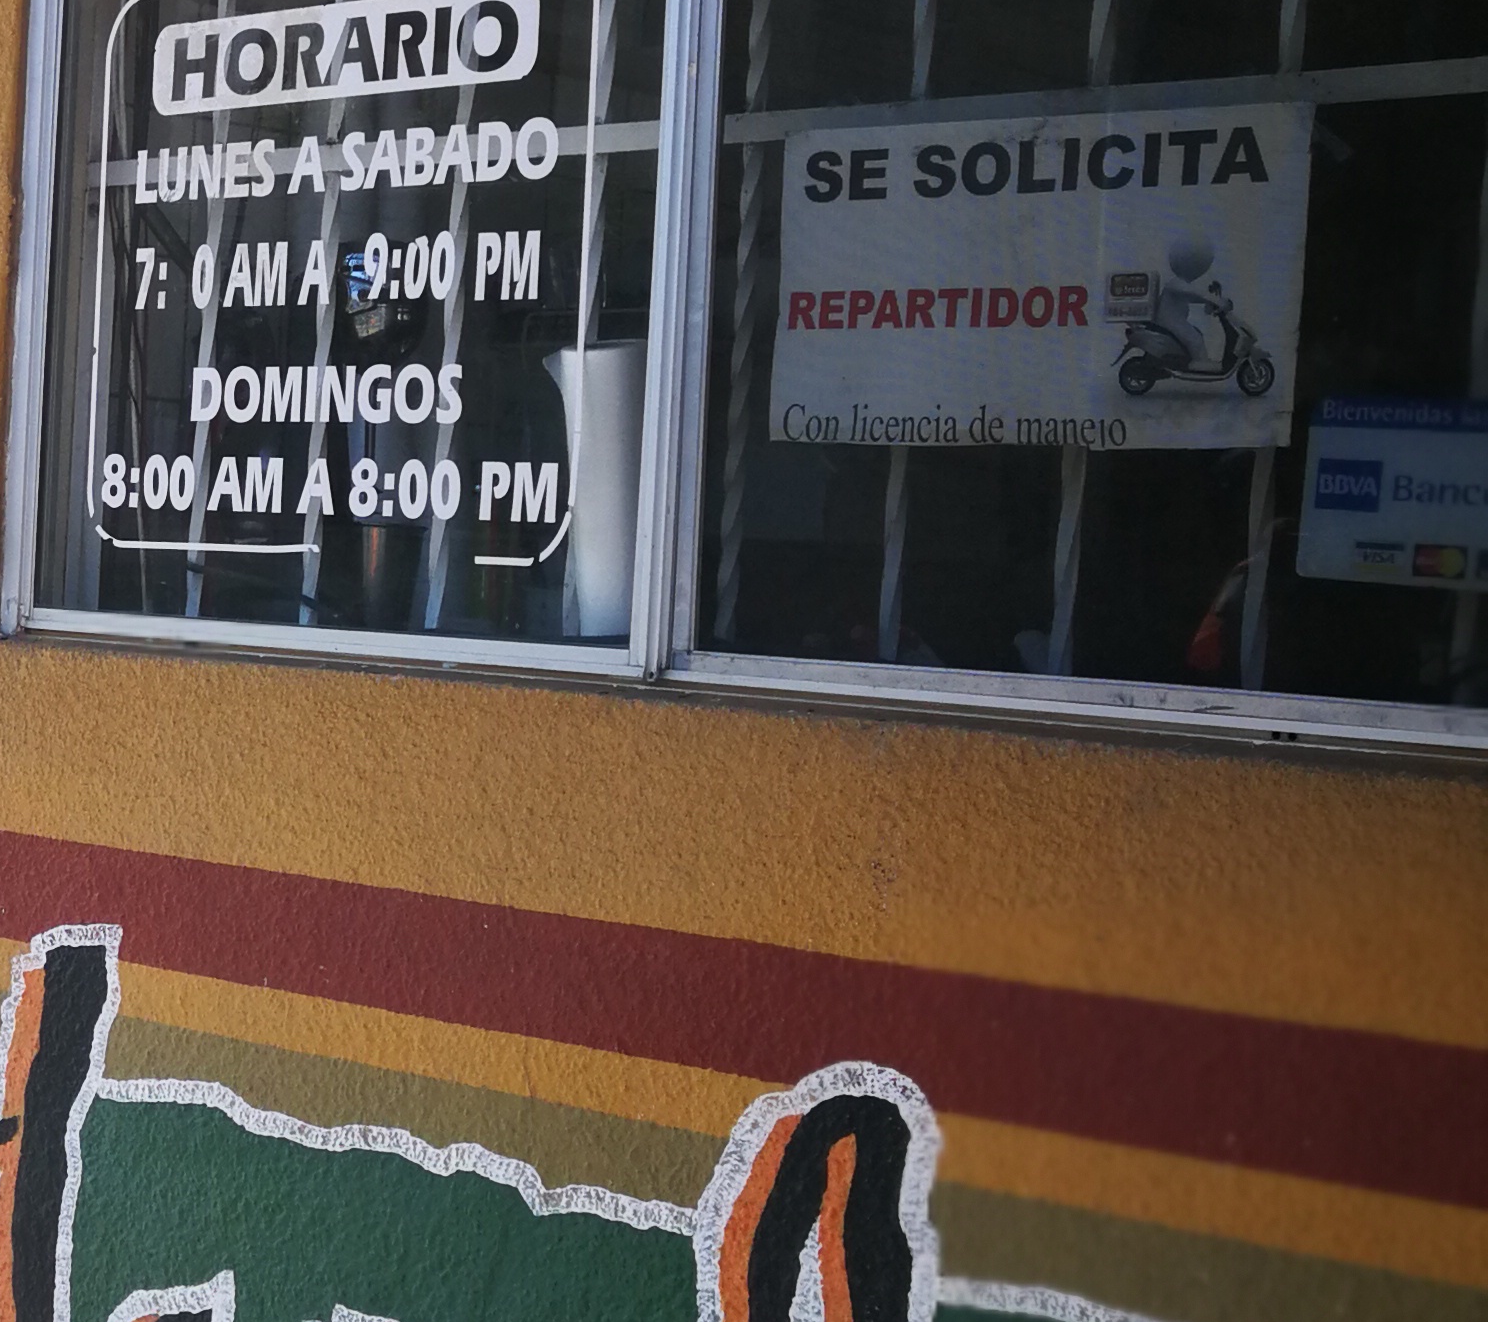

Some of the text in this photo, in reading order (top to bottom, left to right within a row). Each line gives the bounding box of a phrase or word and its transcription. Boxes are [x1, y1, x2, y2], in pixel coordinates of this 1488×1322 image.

[169, 0, 520, 102] HORARIO
[134, 116, 559, 205] LUNES A SABADO
[803, 126, 1269, 203] SE SOLICITA
[222, 241, 289, 308] AM
[297, 239, 330, 305] A
[363, 230, 456, 301] 9:00
[473, 230, 541, 302] PM
[786, 285, 1089, 330] REPARTIDOR
[190, 363, 463, 424] DOMINGOS
[783, 404, 839, 443] Con
[850, 404, 958, 444] licencia
[968, 405, 1005, 444] de
[1322, 399, 1453, 425] Bienvenidas
[101, 453, 559, 524] 8:00 AM A 8:00 PM
[1318, 474, 1488, 507] BBVA Banc
[1362, 550, 1396, 565] VISA
